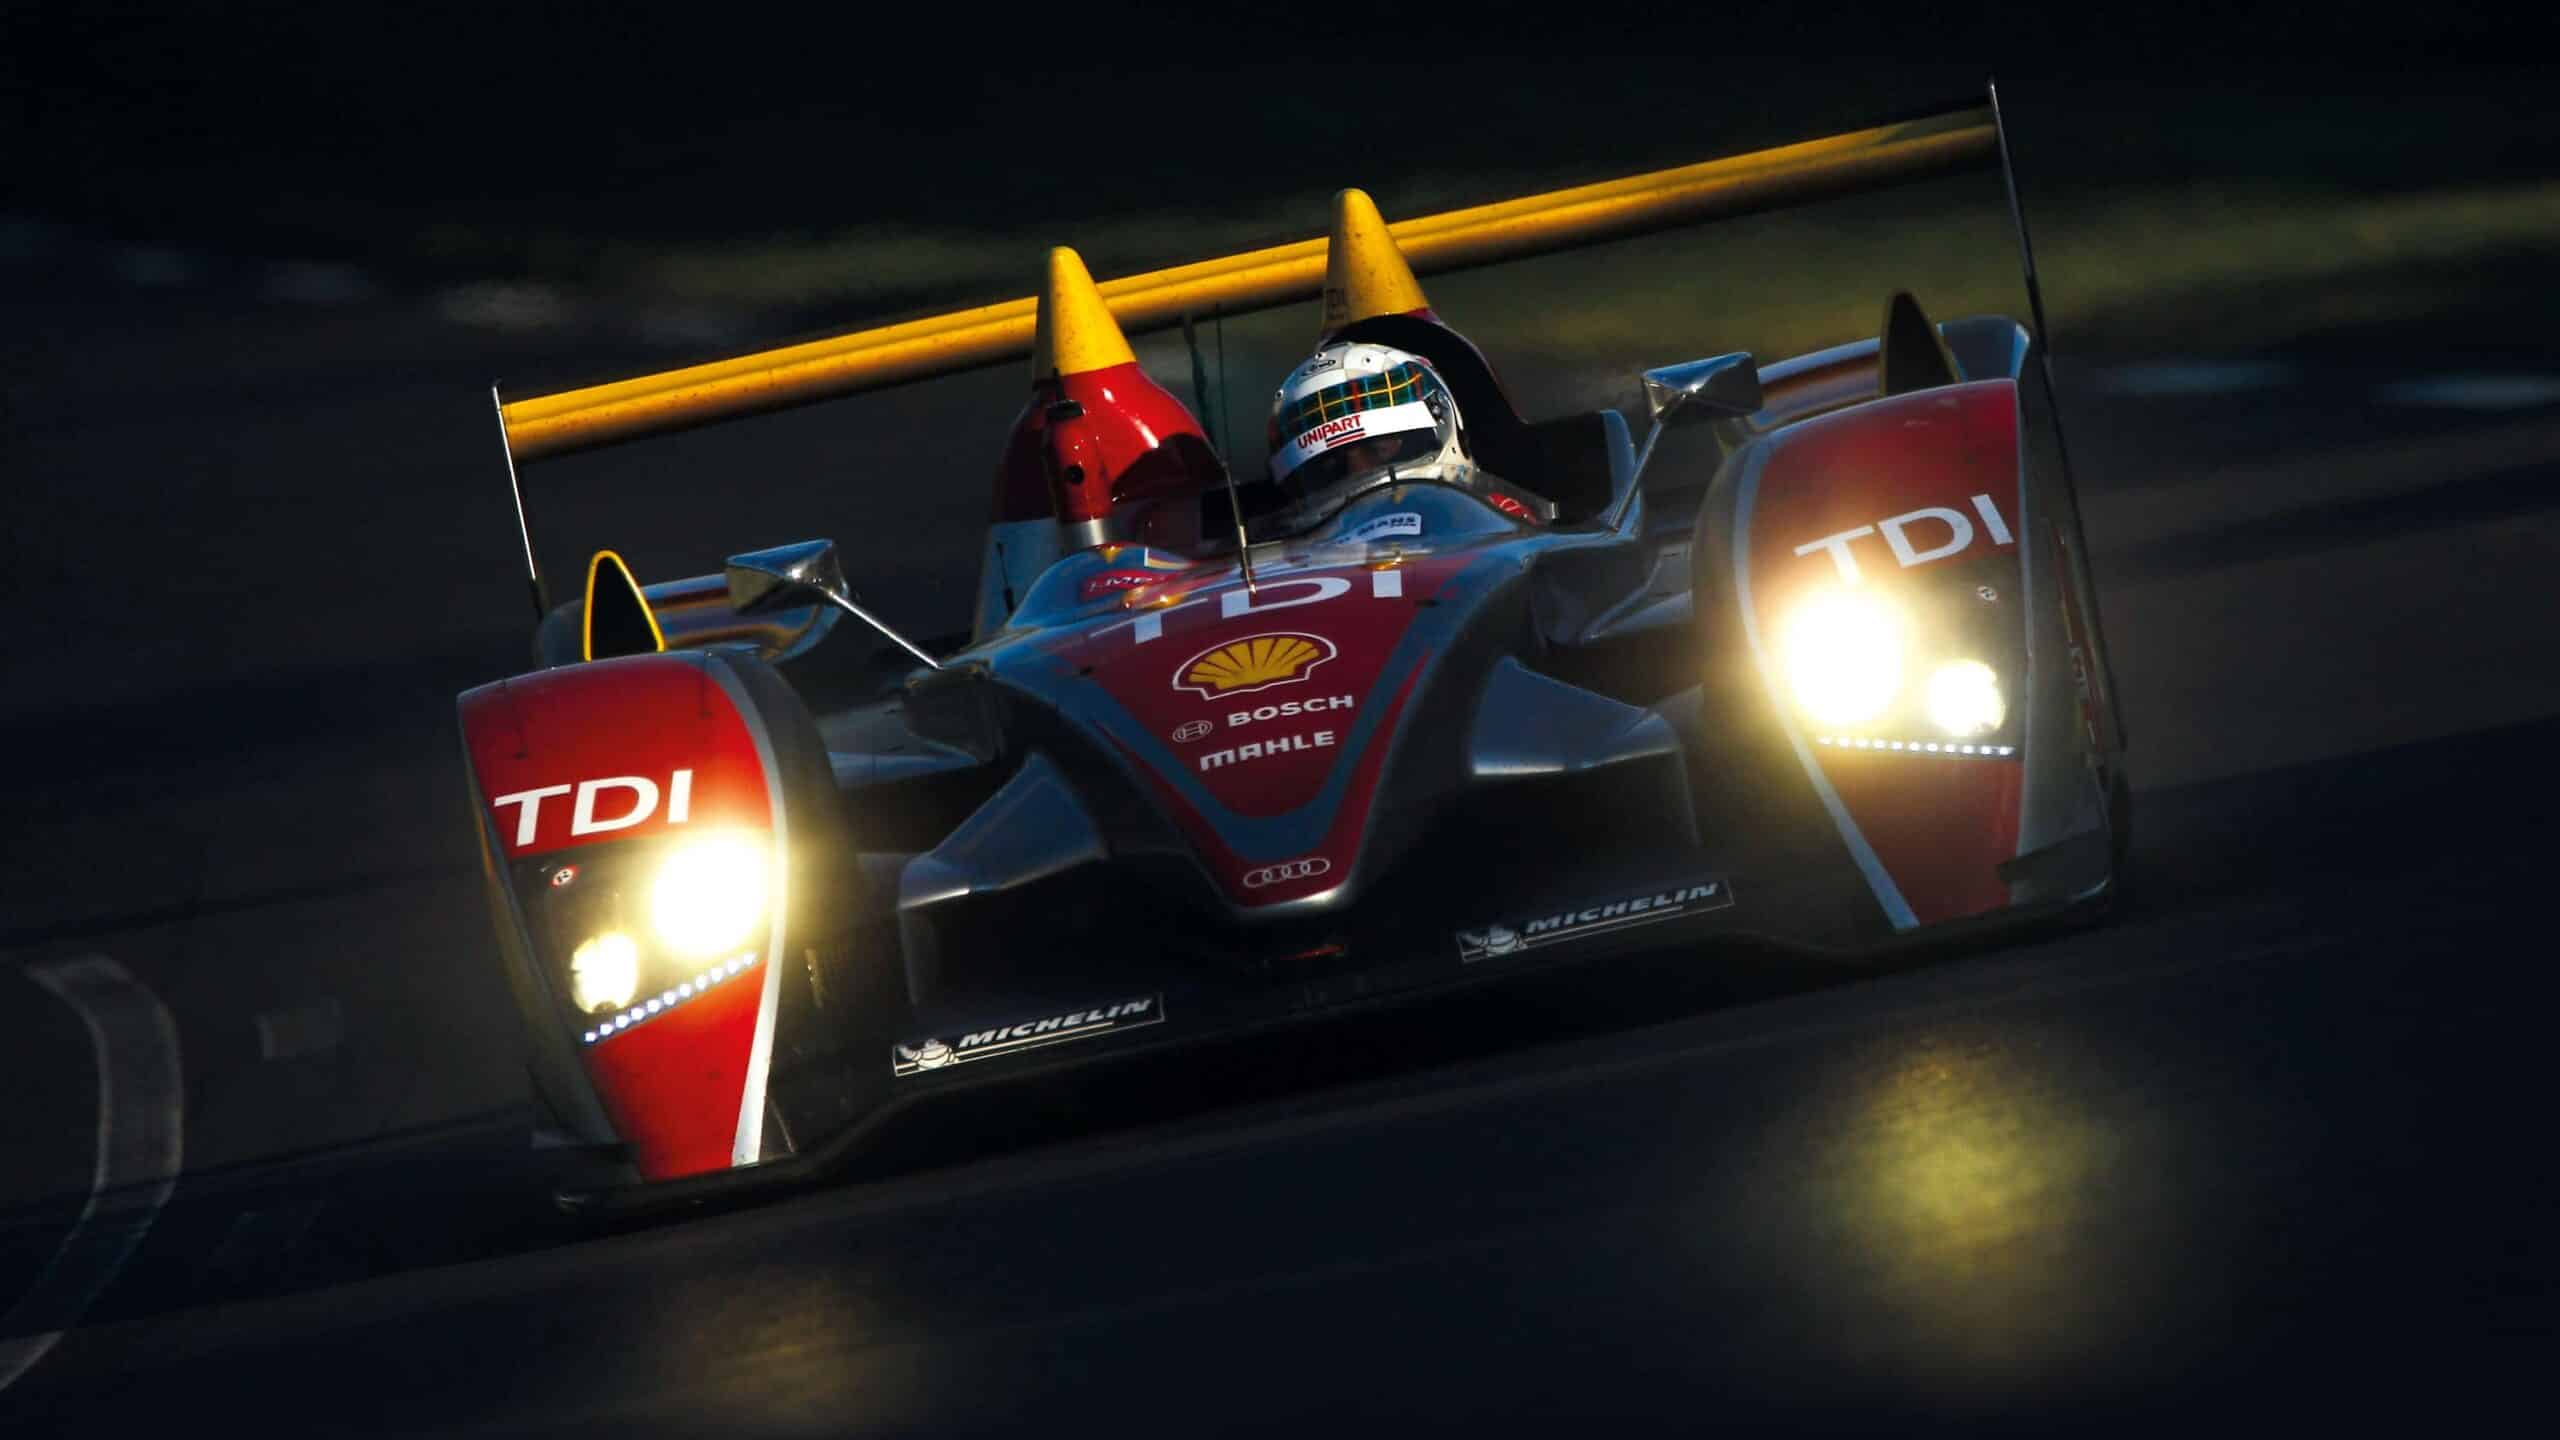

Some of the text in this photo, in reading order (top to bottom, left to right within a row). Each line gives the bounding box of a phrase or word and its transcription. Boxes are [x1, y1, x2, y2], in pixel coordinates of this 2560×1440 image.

[1296, 413, 1362, 449] UNIPART
[1793, 493, 2016, 588] TDI
[1088, 568, 1403, 645] TDI
[1227, 693, 1356, 728] BOSCH
[1199, 730, 1336, 772] MAHLE
[493, 768, 694, 848] TDI
[1524, 881, 1720, 935] MICHELIN
[958, 997, 1154, 1049] MICHELIN
